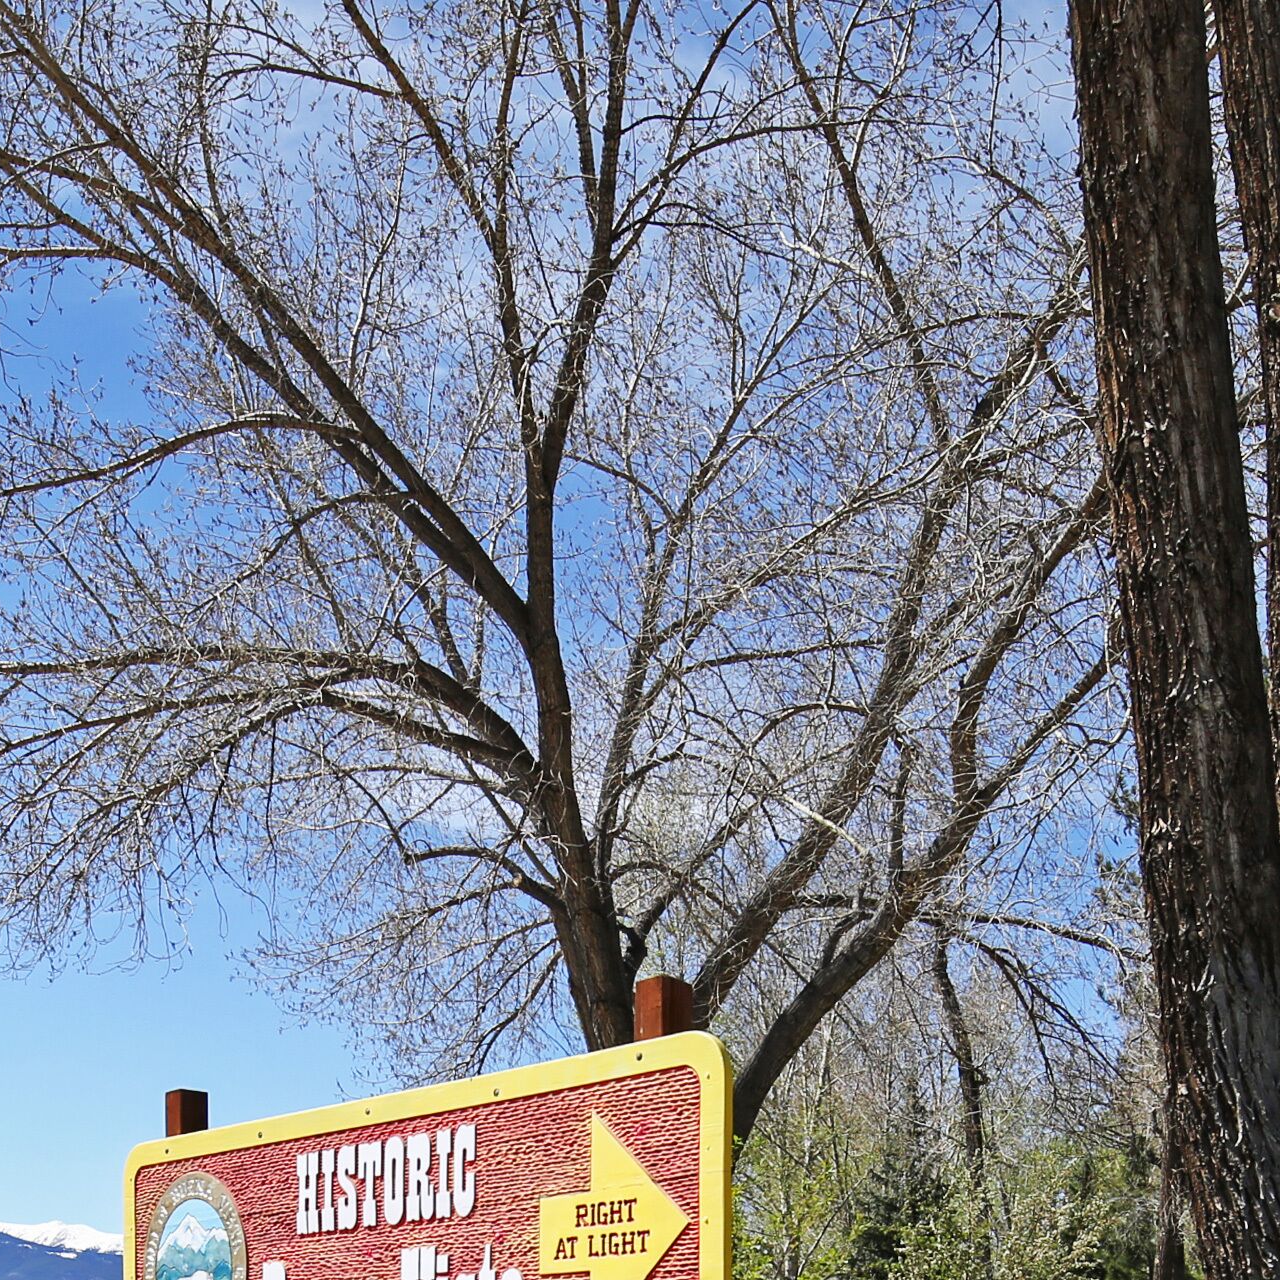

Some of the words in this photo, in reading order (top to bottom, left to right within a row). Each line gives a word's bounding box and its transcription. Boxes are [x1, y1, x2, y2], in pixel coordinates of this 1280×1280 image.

[297, 1124, 476, 1235] HISTORIC
[575, 1198, 637, 1228] RIGHT
[554, 1236, 578, 1260] AT
[587, 1229, 650, 1257] LIGHT
